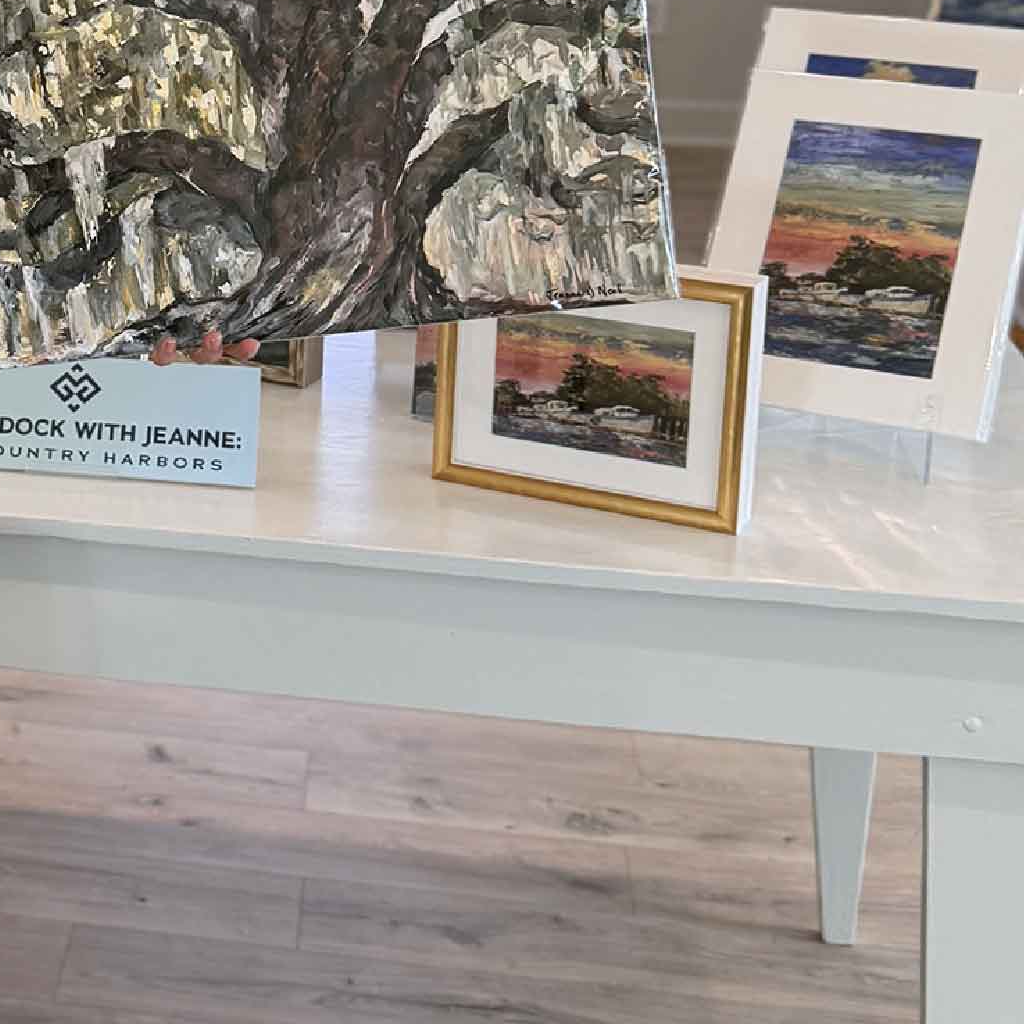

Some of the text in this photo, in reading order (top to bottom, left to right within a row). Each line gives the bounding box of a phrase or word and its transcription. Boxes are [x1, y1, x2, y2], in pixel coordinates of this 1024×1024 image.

[0, 417, 65, 438] DOCK
[75, 422, 136, 442] WITH
[141, 426, 241, 449] JEANNE:
[104, 451, 223, 470] HARBORS
